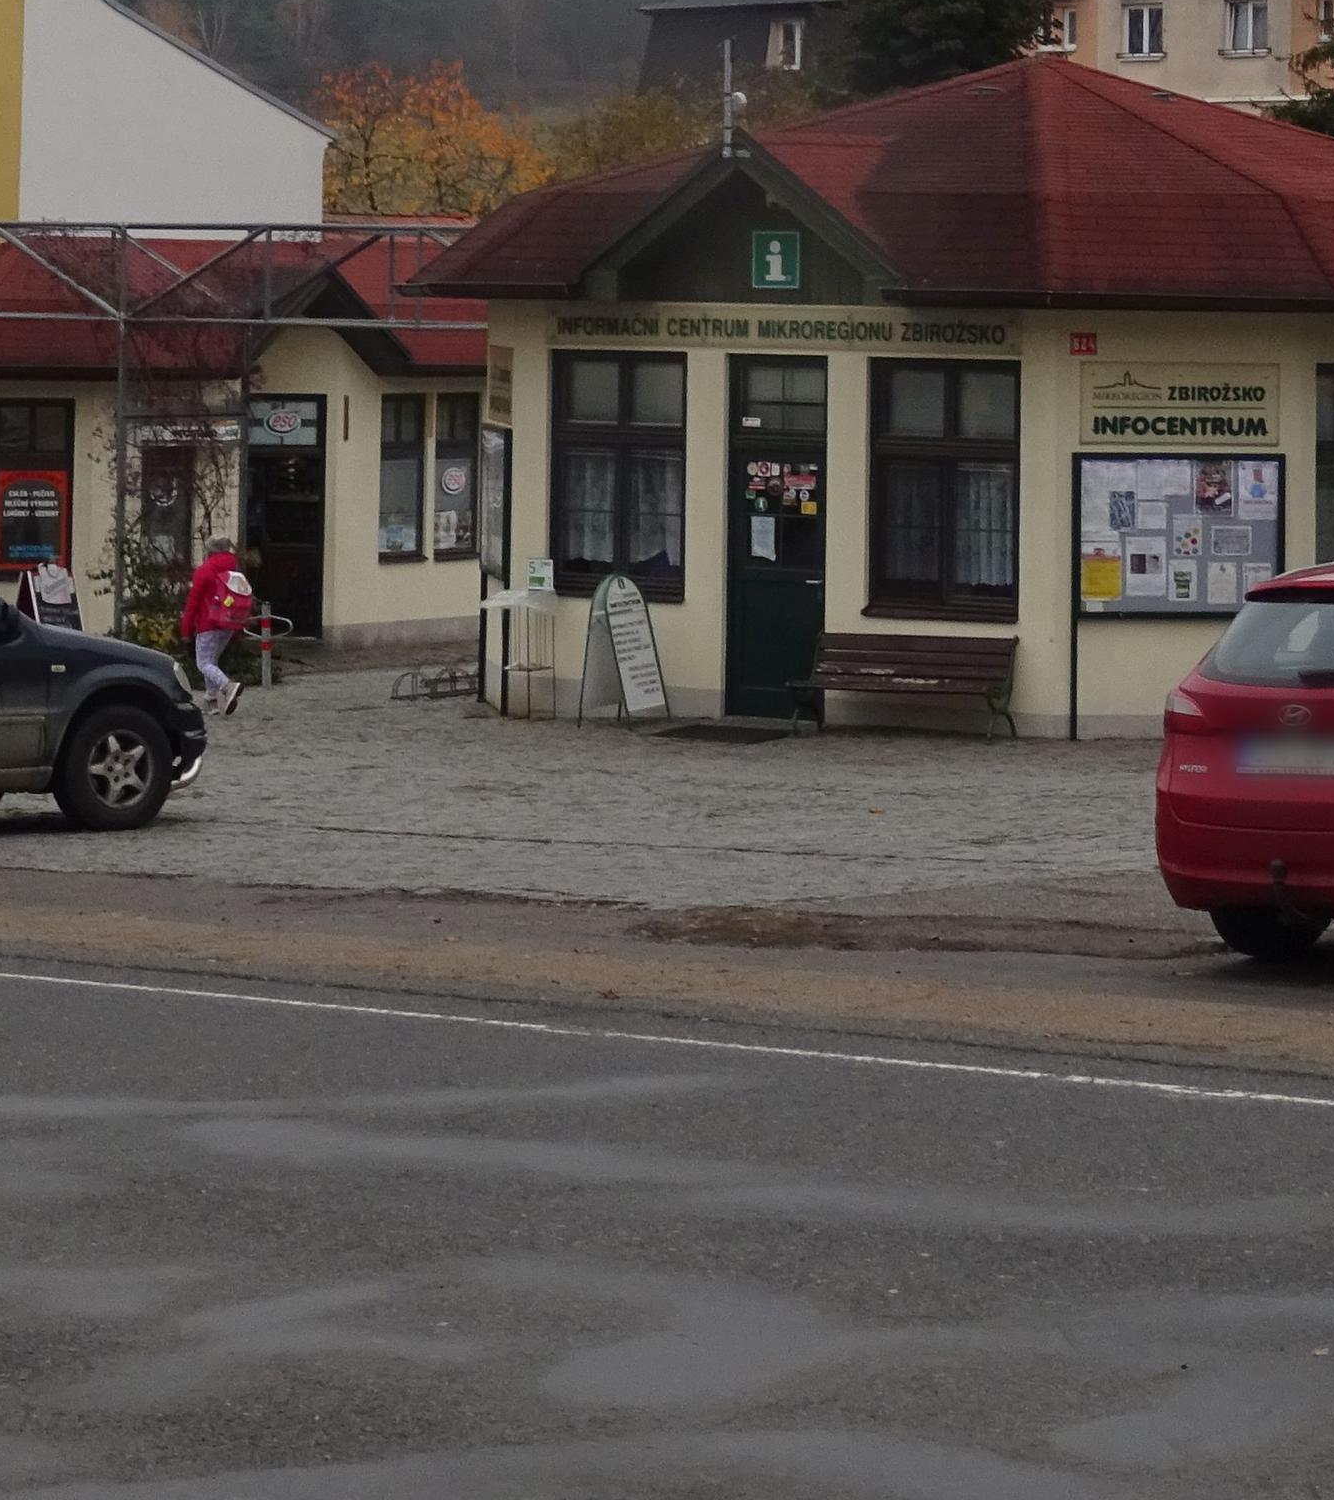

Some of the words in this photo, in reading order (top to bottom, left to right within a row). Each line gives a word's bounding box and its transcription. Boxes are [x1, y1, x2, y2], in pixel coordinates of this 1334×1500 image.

[667, 318, 749, 339] CENTRUM
[758, 320, 893, 342] MIKROREGIONU
[900, 319, 1006, 346] ZBIROŽSKO
[1168, 382, 1266, 403] ZBIROŽSKO
[1093, 416, 1268, 436] INFOCENTRUM
